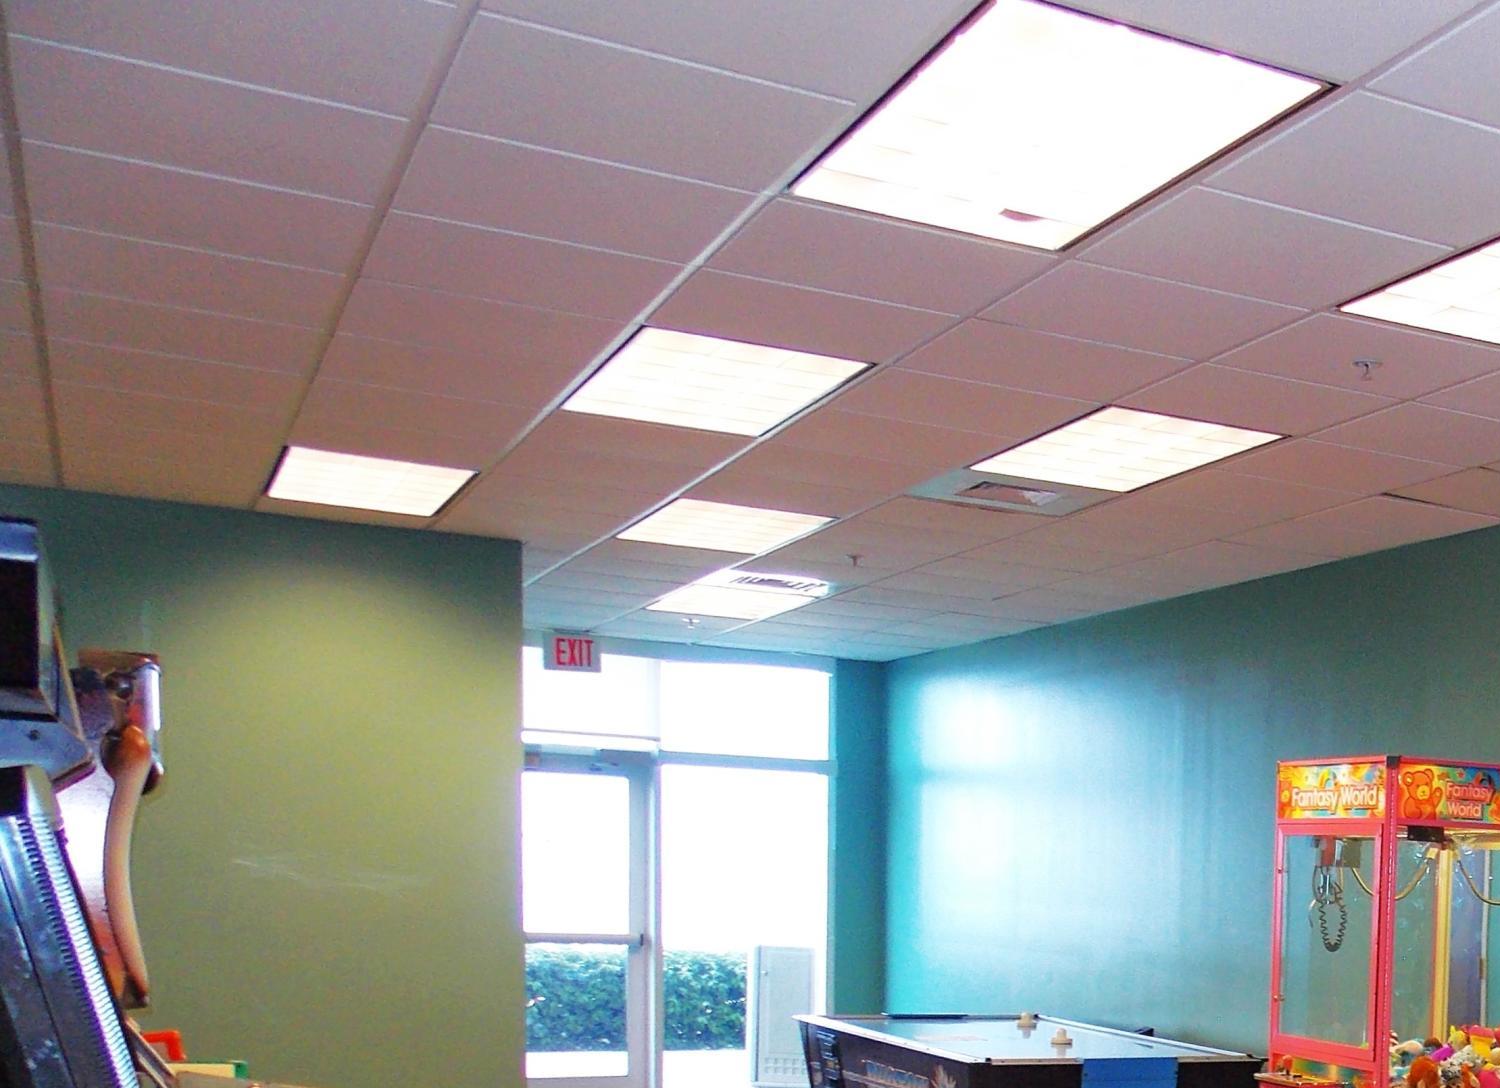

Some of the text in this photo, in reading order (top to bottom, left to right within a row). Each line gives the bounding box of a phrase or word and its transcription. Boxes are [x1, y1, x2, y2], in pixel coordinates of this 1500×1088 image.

[555, 637, 593, 667] EXIT
[1291, 784, 1378, 814] Fantasy World
[1447, 782, 1494, 804] Fantasy
[1448, 802, 1482, 818] World
